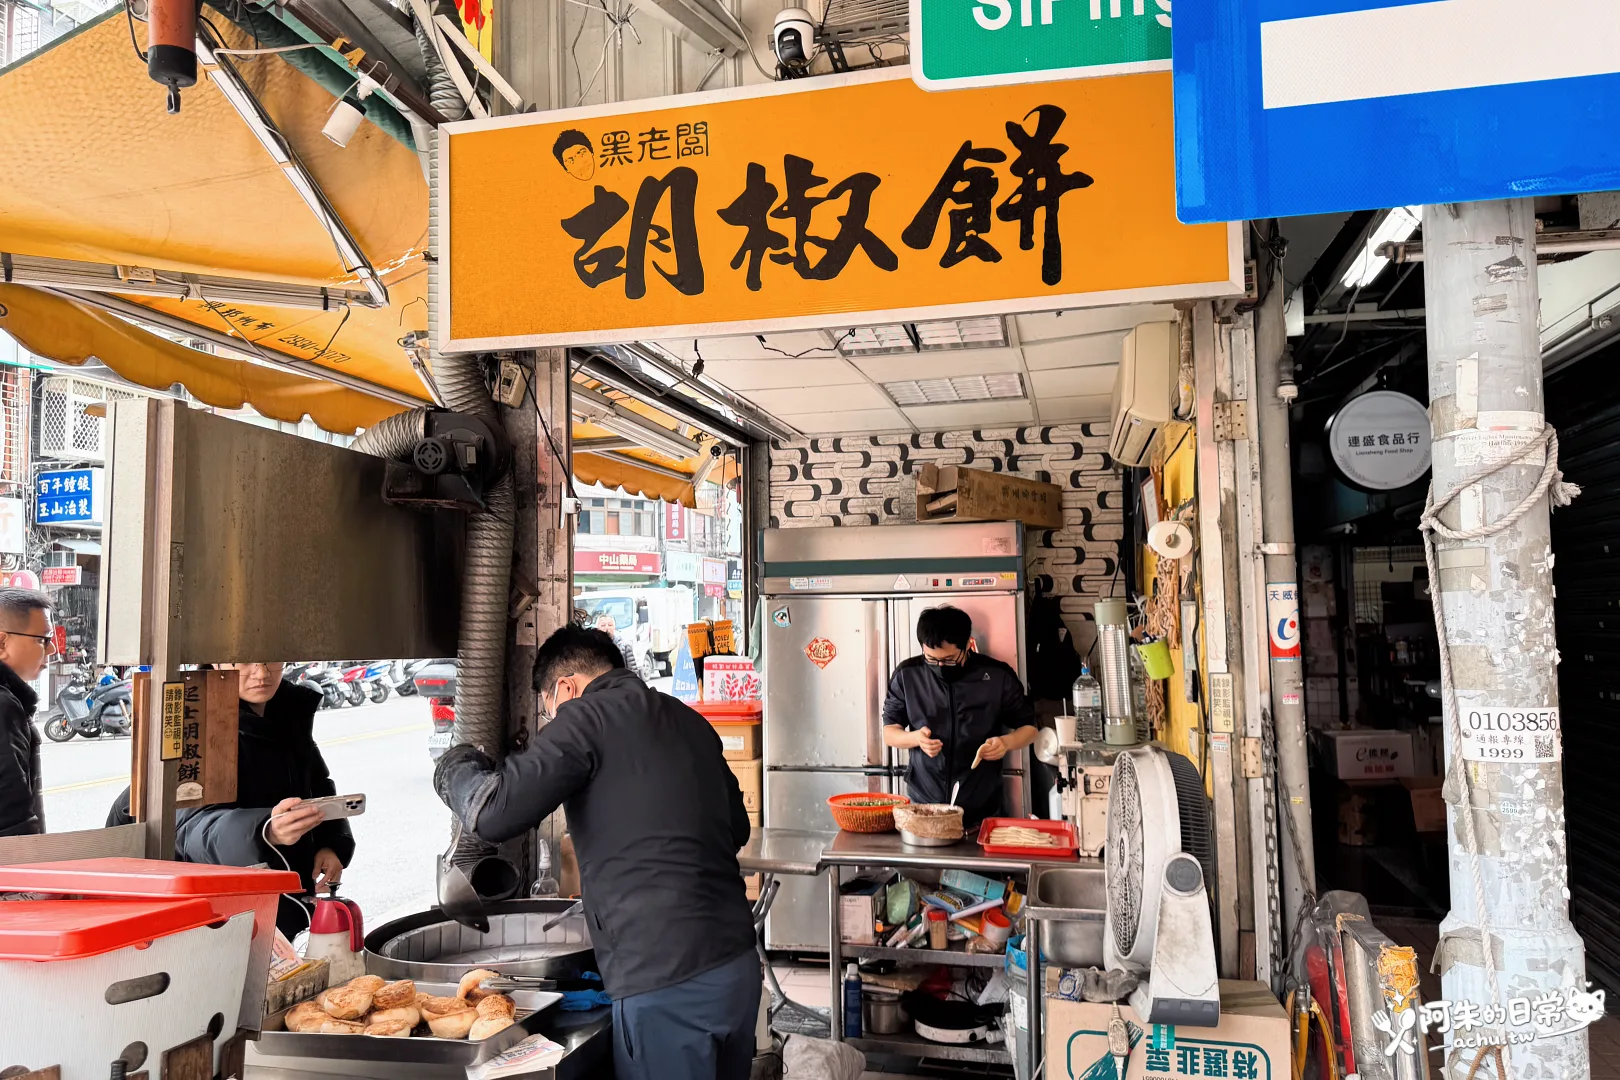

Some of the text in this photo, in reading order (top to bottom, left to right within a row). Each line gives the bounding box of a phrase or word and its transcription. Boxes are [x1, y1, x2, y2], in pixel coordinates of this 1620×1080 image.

[600, 121, 709, 168] 黑老闆
[560, 104, 1095, 300] 胡椒餅
[1347, 432, 1421, 447] 連盛食品行
[164, 689, 174, 728] 請微笑
[1212, 678, 1222, 708] 請微笑
[1221, 678, 1232, 728] 錄影監視中
[173, 688, 183, 757] 錄影監視中
[1469, 711, 1557, 731] 0103856
[1475, 733, 1525, 746] 通報專線
[1478, 747, 1524, 759] 1999
